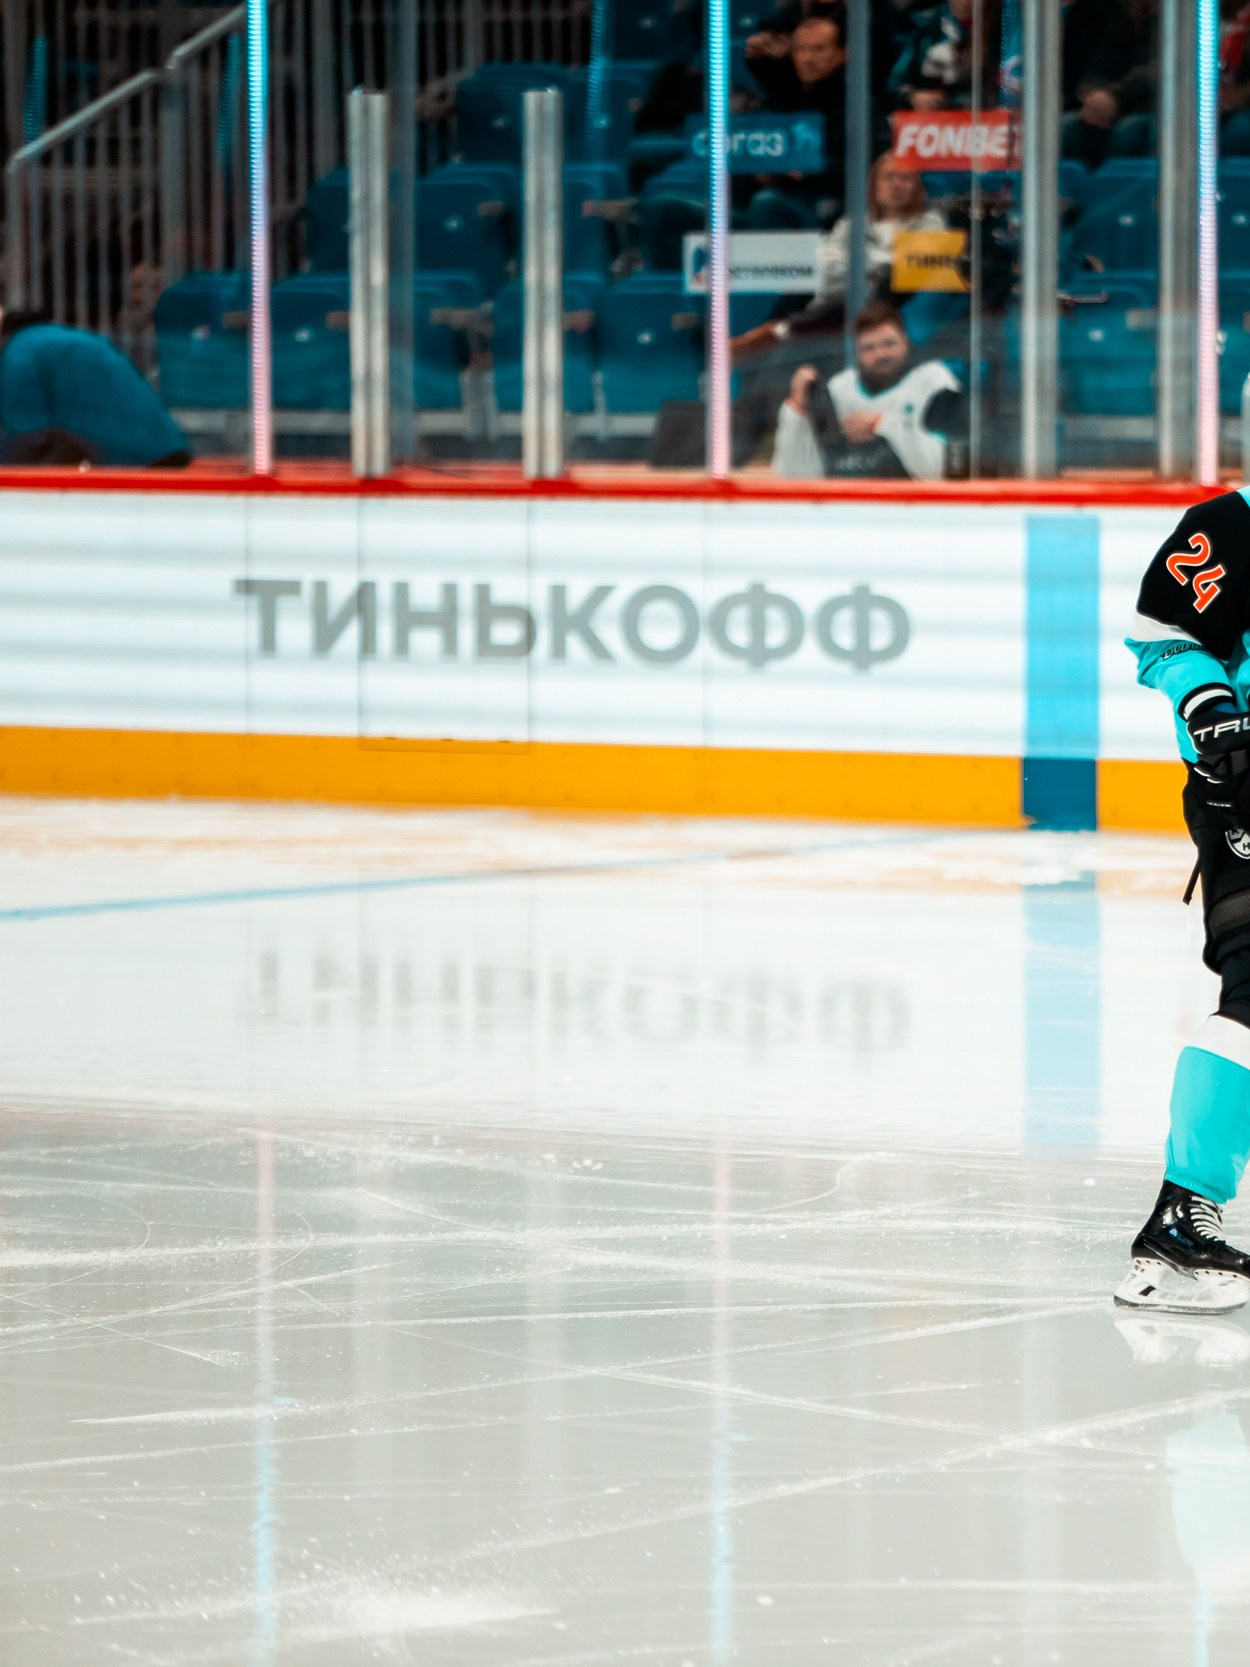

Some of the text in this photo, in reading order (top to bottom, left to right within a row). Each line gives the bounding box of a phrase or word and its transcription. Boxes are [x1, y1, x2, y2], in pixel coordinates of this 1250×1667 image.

[692, 132, 784, 157] сгаз
[1165, 532, 1226, 614] 24
[233, 578, 911, 672] ТИНЬКОФФ
